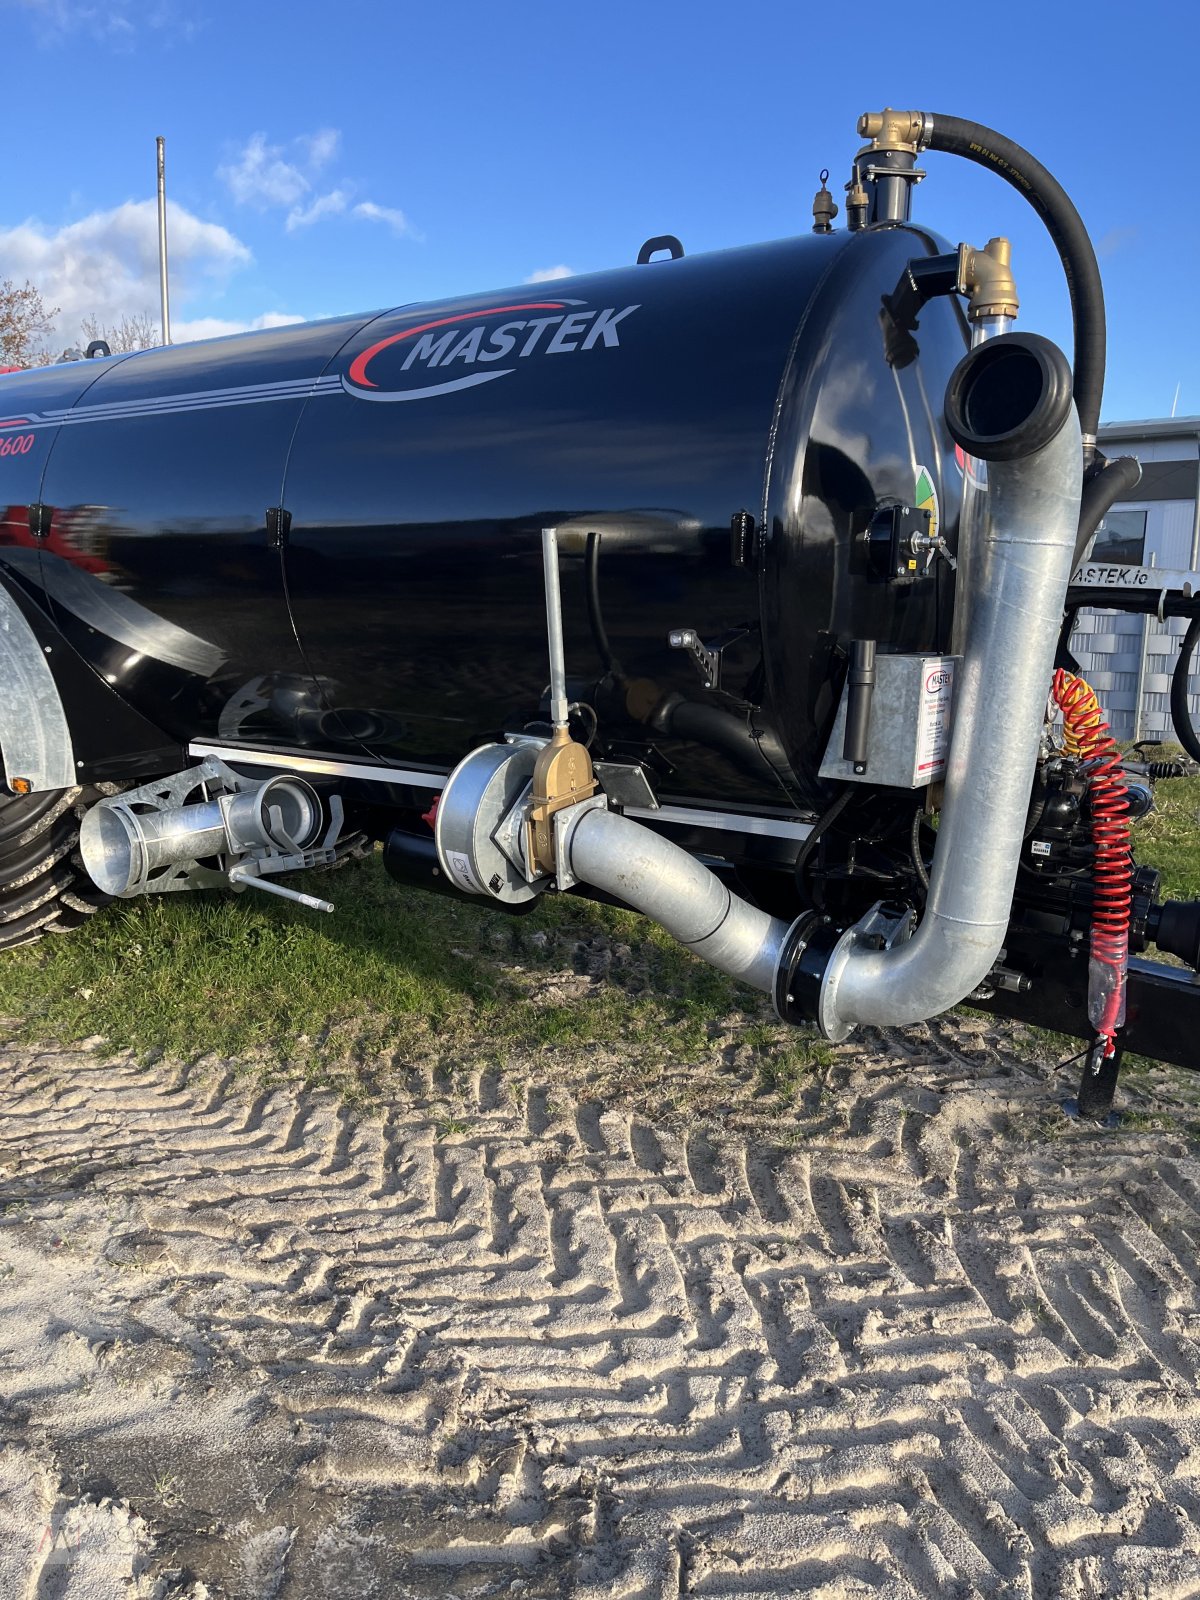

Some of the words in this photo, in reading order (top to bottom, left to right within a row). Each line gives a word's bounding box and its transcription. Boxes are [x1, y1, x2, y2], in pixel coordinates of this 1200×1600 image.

[400, 304, 642, 371] MASTEK
[1071, 568, 1148, 585] ASTEK.ie
[931, 673, 952, 686] MASTEK
